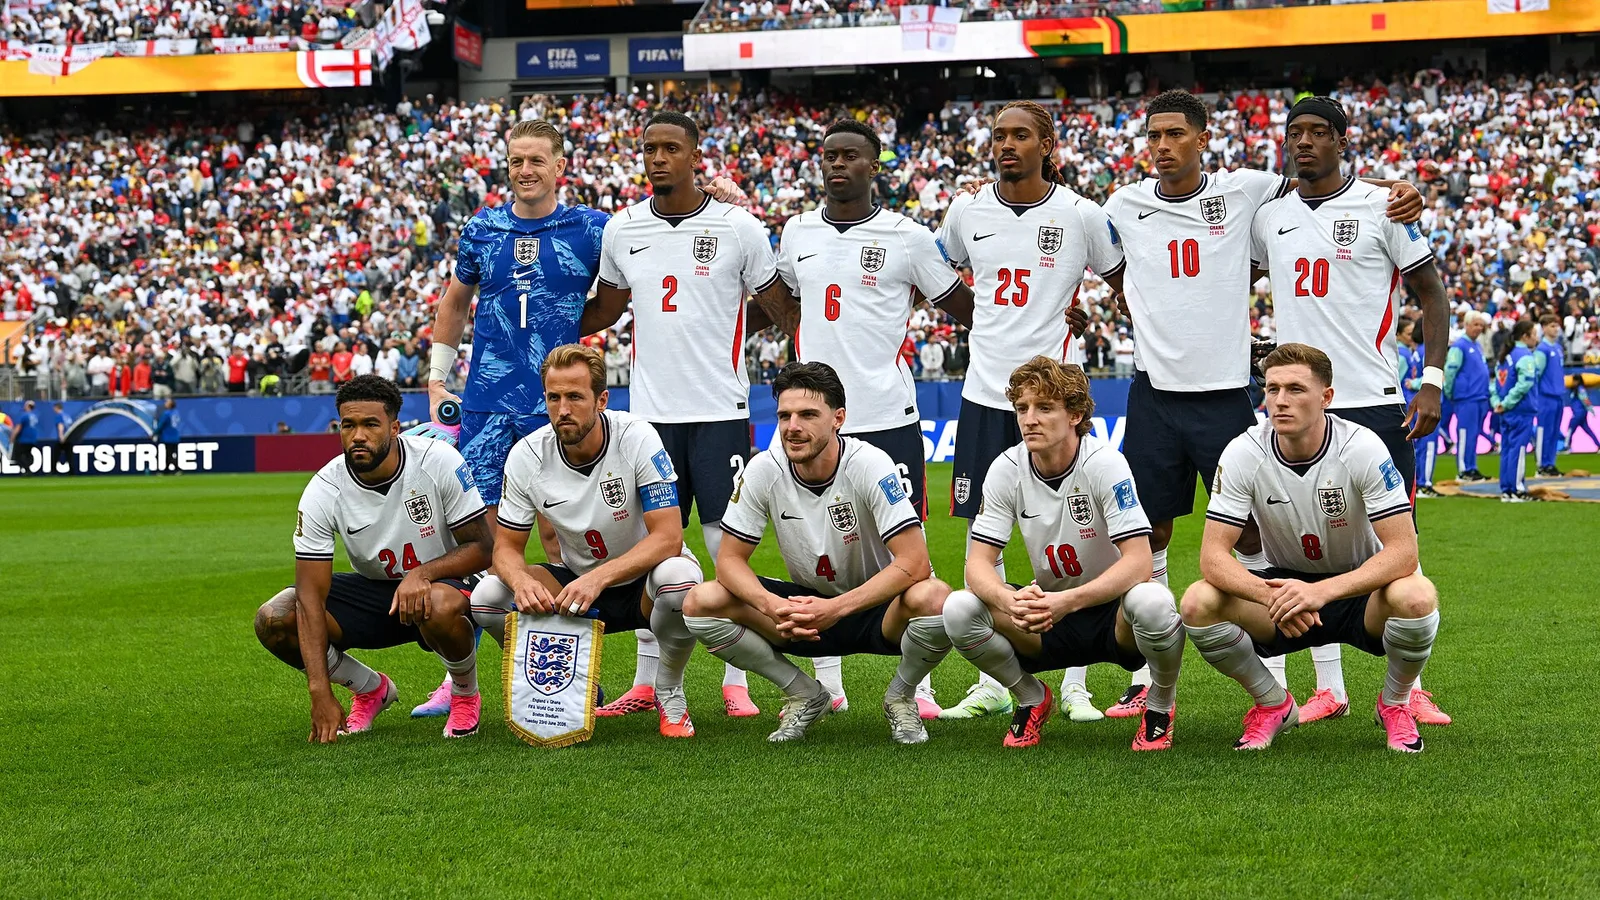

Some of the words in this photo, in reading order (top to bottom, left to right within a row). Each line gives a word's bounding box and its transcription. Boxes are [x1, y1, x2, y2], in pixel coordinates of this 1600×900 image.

[548, 48, 576, 60] FIFA
[548, 60, 577, 69] STORE
[638, 50, 668, 62] FIFA
[1168, 238, 1200, 278] 10
[662, 275, 678, 312] 2
[994, 268, 1030, 307] 25
[1295, 258, 1330, 298] 20
[518, 294, 528, 328] 1
[824, 284, 842, 321] 6
[730, 454, 745, 490] 2
[895, 462, 913, 498] 6
[649, 487, 673, 497] UNITES
[378, 542, 422, 579] 24
[584, 529, 608, 560] 9
[1045, 543, 1083, 579] 18
[1301, 534, 1323, 560] 8
[816, 554, 837, 582] 4
